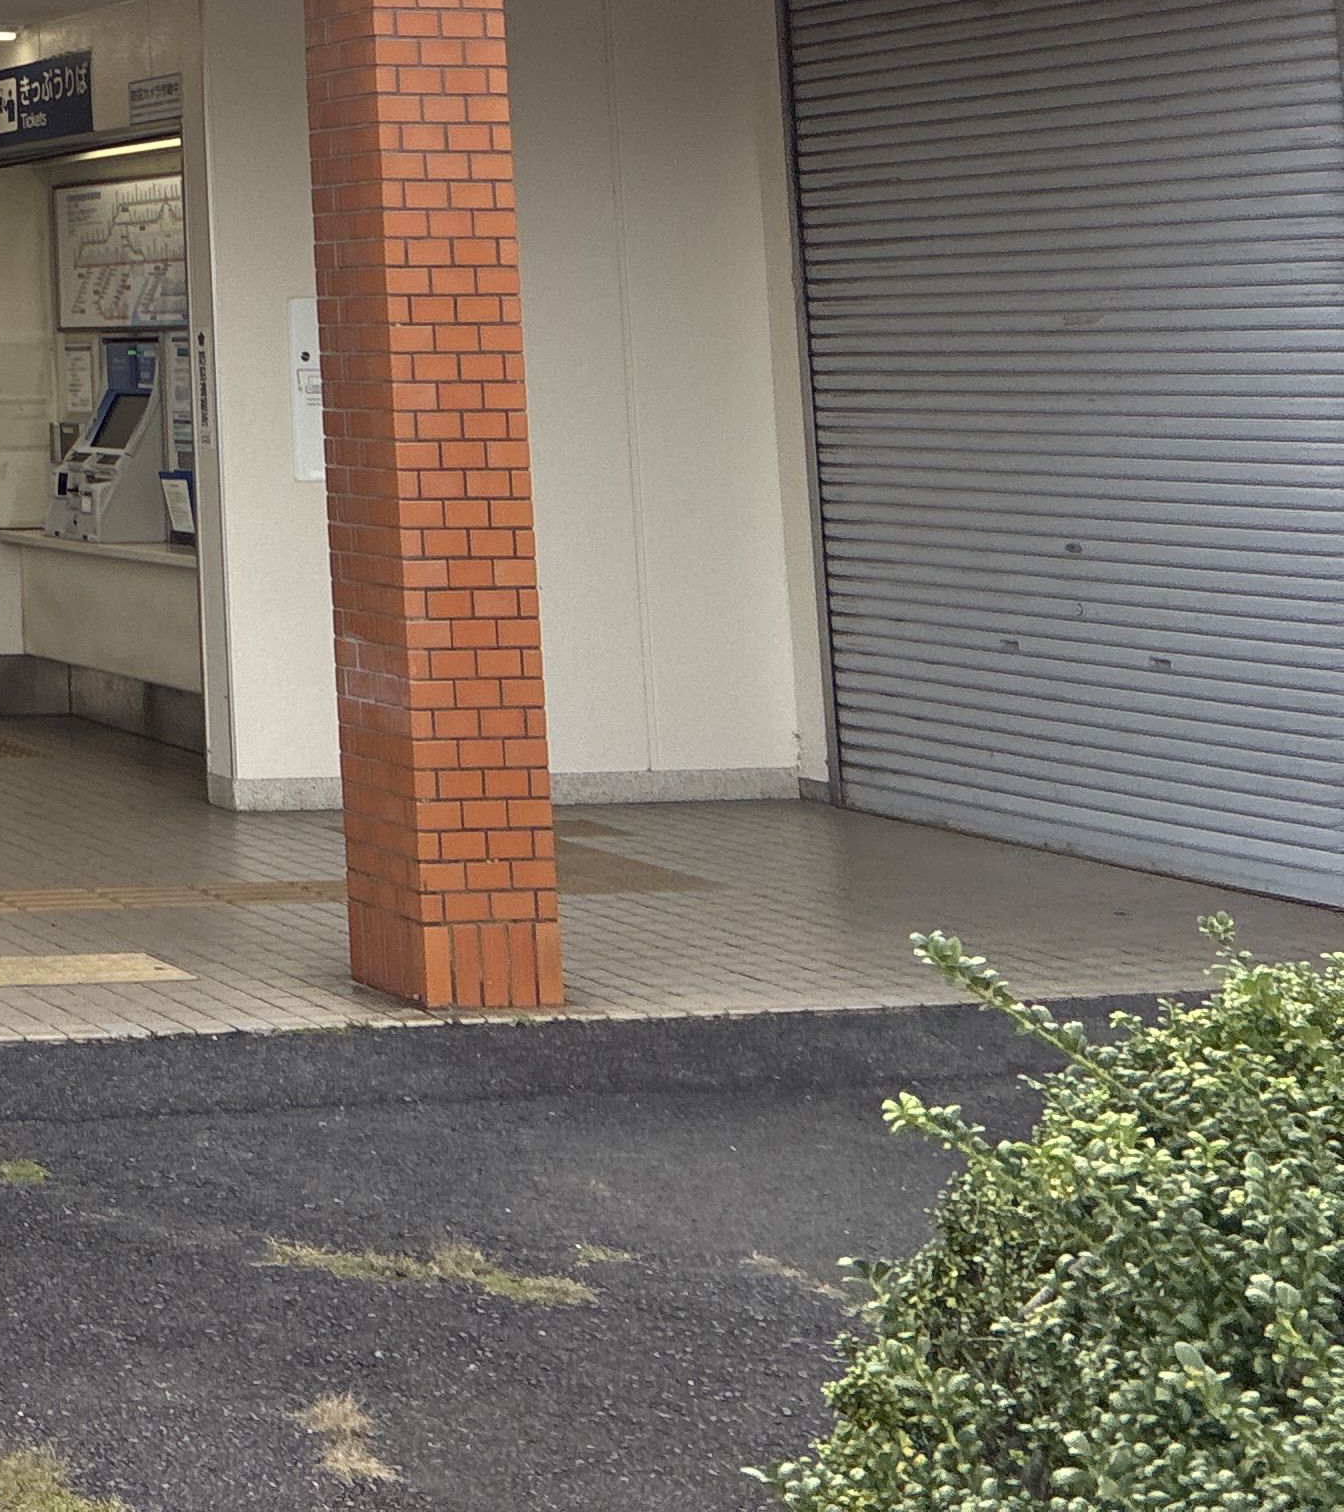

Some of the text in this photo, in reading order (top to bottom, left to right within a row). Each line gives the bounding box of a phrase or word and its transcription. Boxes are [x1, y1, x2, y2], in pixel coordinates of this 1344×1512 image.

[19, 63, 88, 106] きっぷうりば
[20, 110, 48, 129] Tickets
